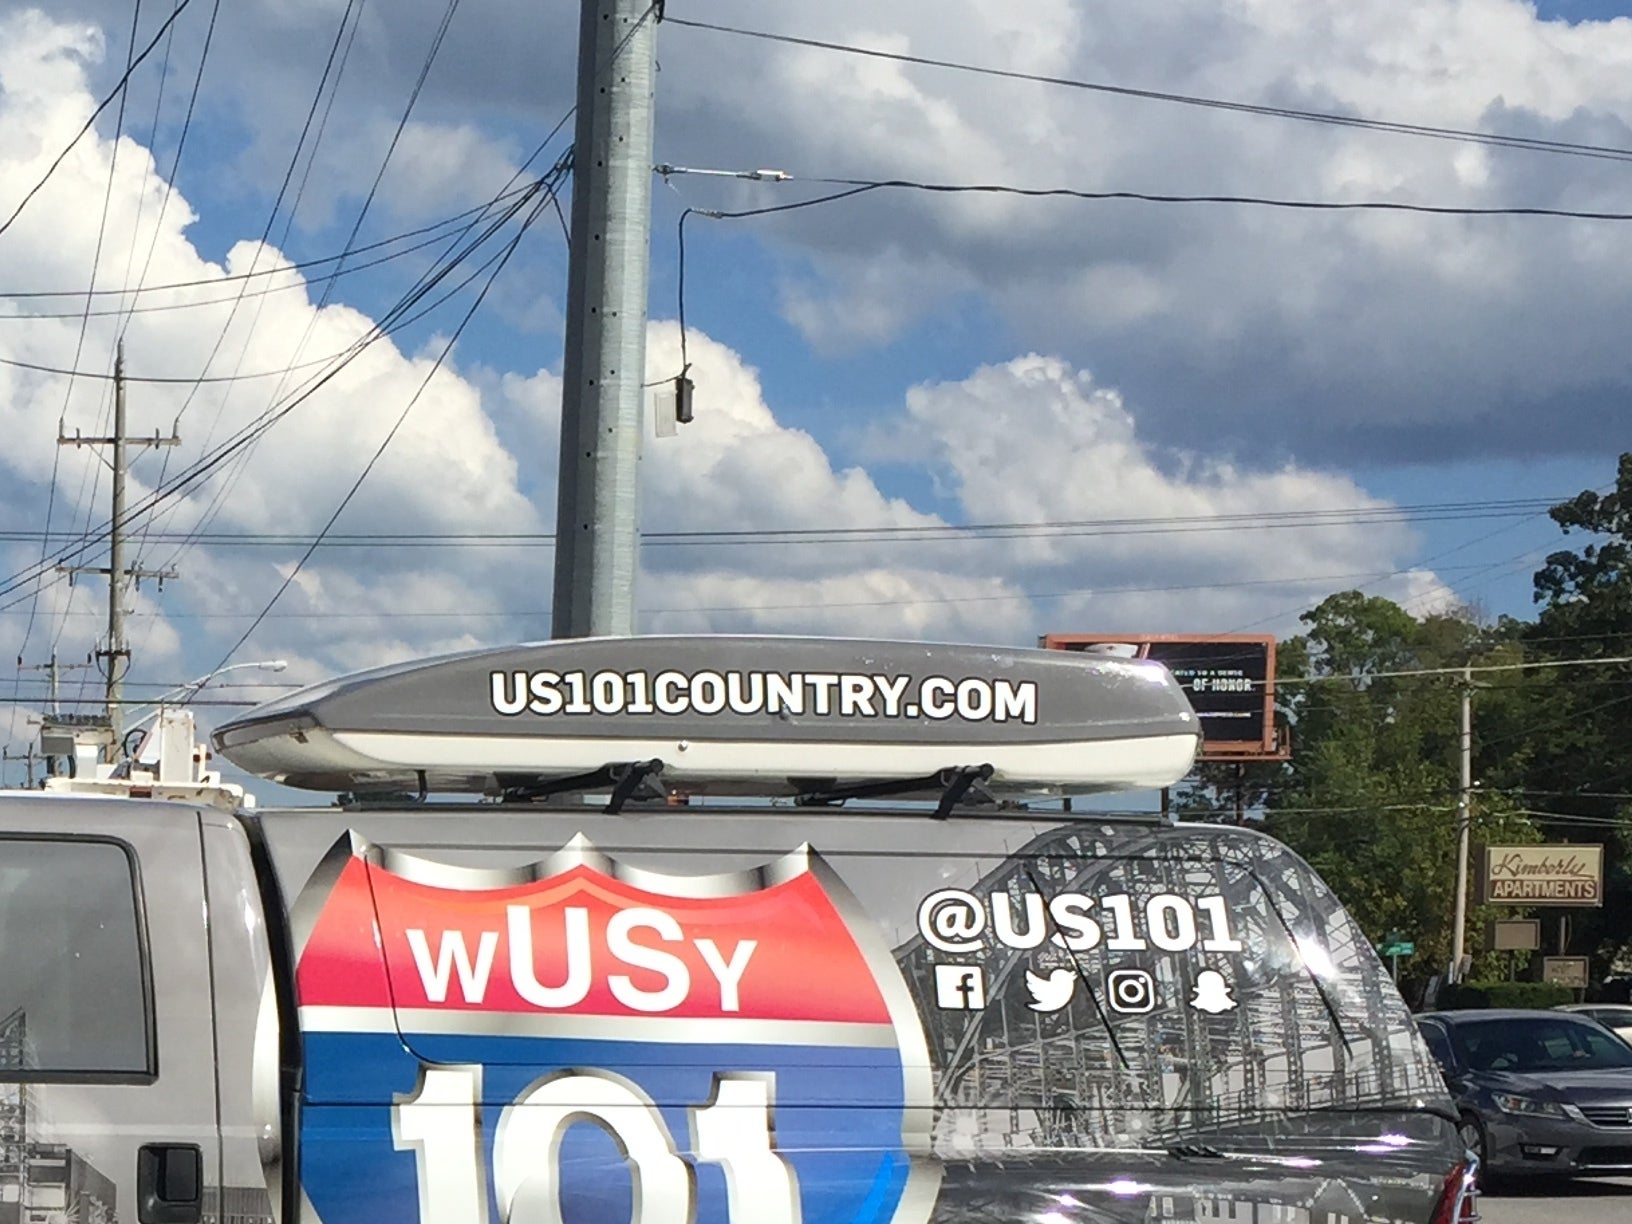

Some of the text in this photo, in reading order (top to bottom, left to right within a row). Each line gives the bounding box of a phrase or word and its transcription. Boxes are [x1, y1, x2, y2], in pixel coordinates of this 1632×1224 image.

[490, 671, 1037, 723] US101COUNTRY.COM
[1193, 678, 1208, 692] OF
[1491, 853, 1595, 879] Kimberly
[1493, 880, 1595, 898] APARTMENTS
[917, 888, 1243, 953] @US101
